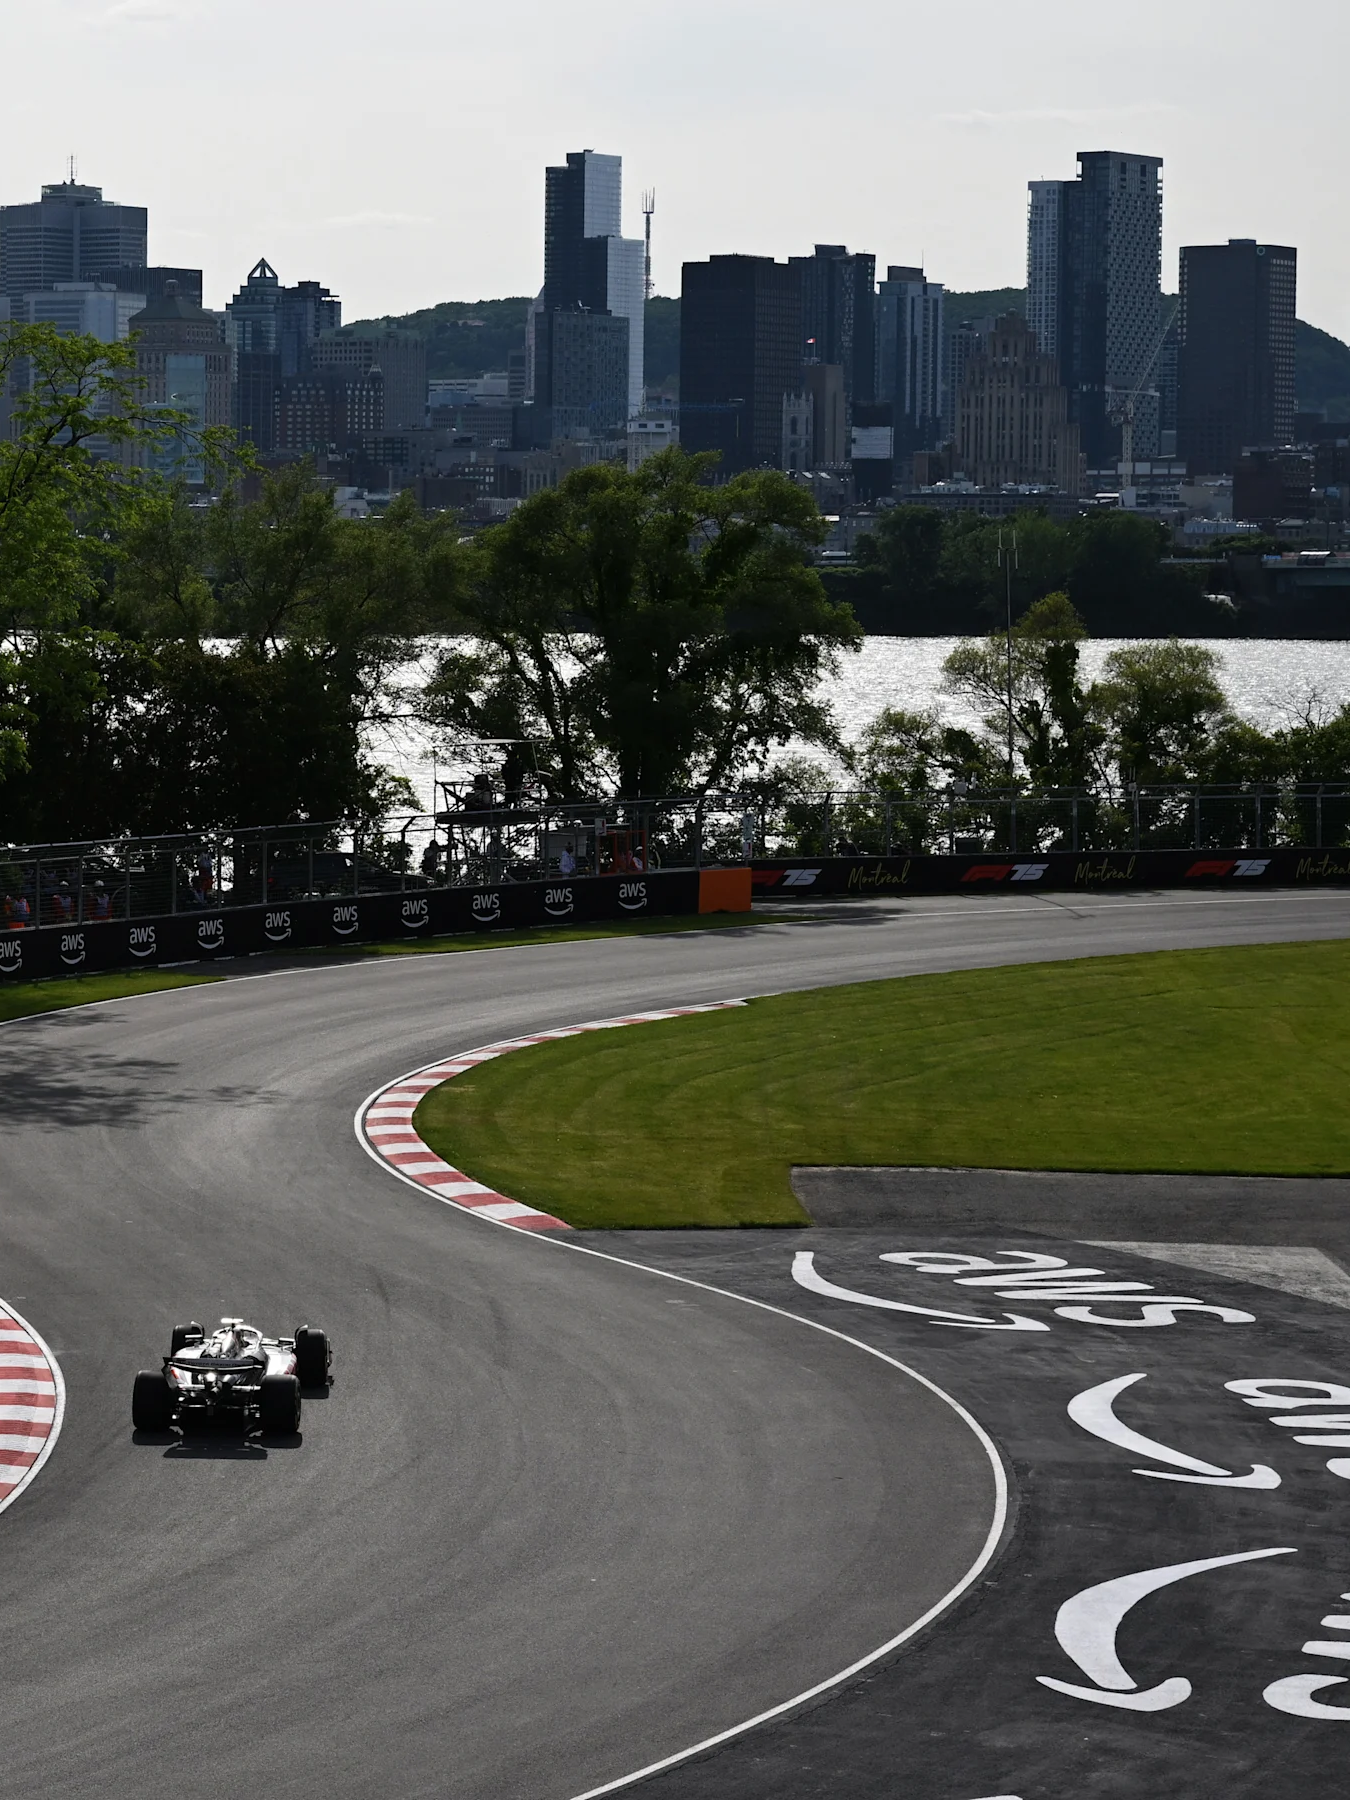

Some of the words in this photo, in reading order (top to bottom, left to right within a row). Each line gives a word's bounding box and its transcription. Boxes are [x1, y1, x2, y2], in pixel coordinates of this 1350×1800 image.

[1010, 863, 1050, 881] 75
[1232, 859, 1272, 877] 75
[781, 868, 823, 887] 75
[545, 887, 573, 904] aws
[619, 881, 647, 898] aws
[402, 899, 428, 916] aws
[472, 893, 500, 910] aws
[265, 911, 290, 929] aws
[333, 905, 358, 922] aws
[129, 926, 156, 944] aws
[198, 919, 224, 937] aws
[61, 934, 85, 951] aws
[878, 1250, 1256, 1327] aws
